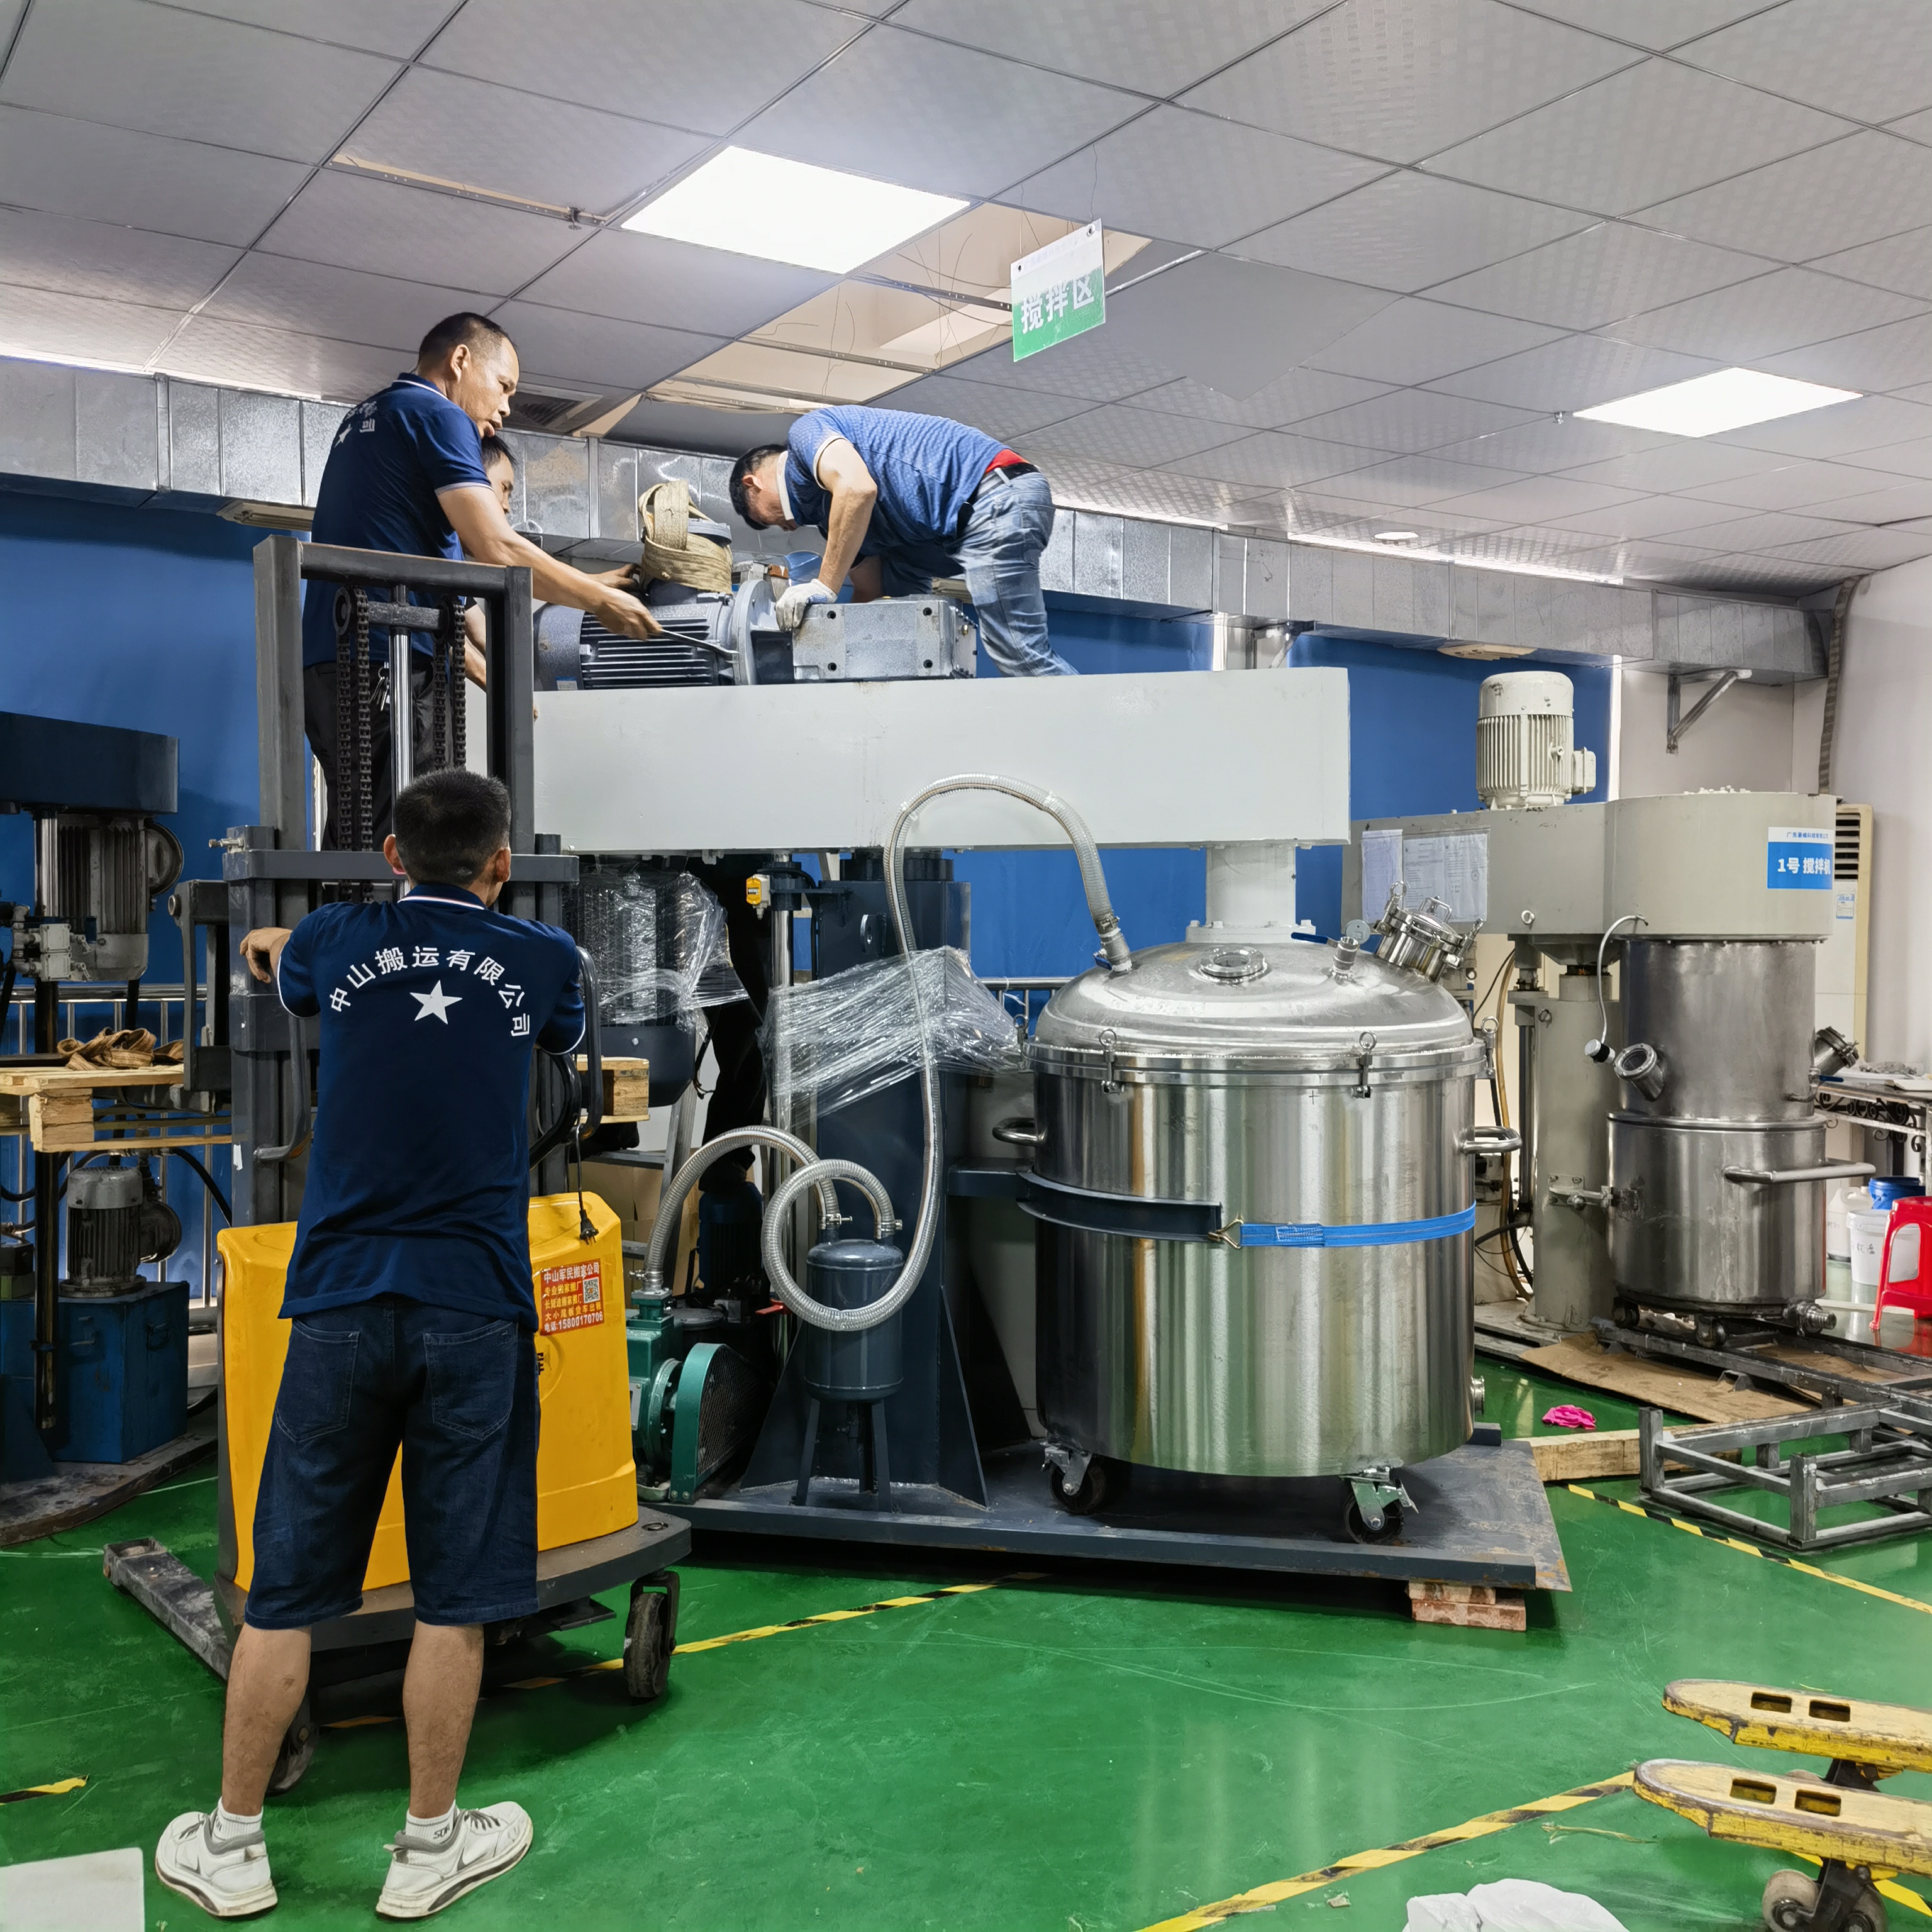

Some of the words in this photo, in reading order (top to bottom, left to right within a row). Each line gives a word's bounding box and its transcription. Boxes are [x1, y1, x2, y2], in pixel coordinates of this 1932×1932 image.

[1020, 275, 1094, 335] 搅拌区
[1777, 857, 1800, 874] 1号
[1803, 857, 1830, 875] 搅拌机
[329, 945, 530, 1037] 中山搬运有限公司
